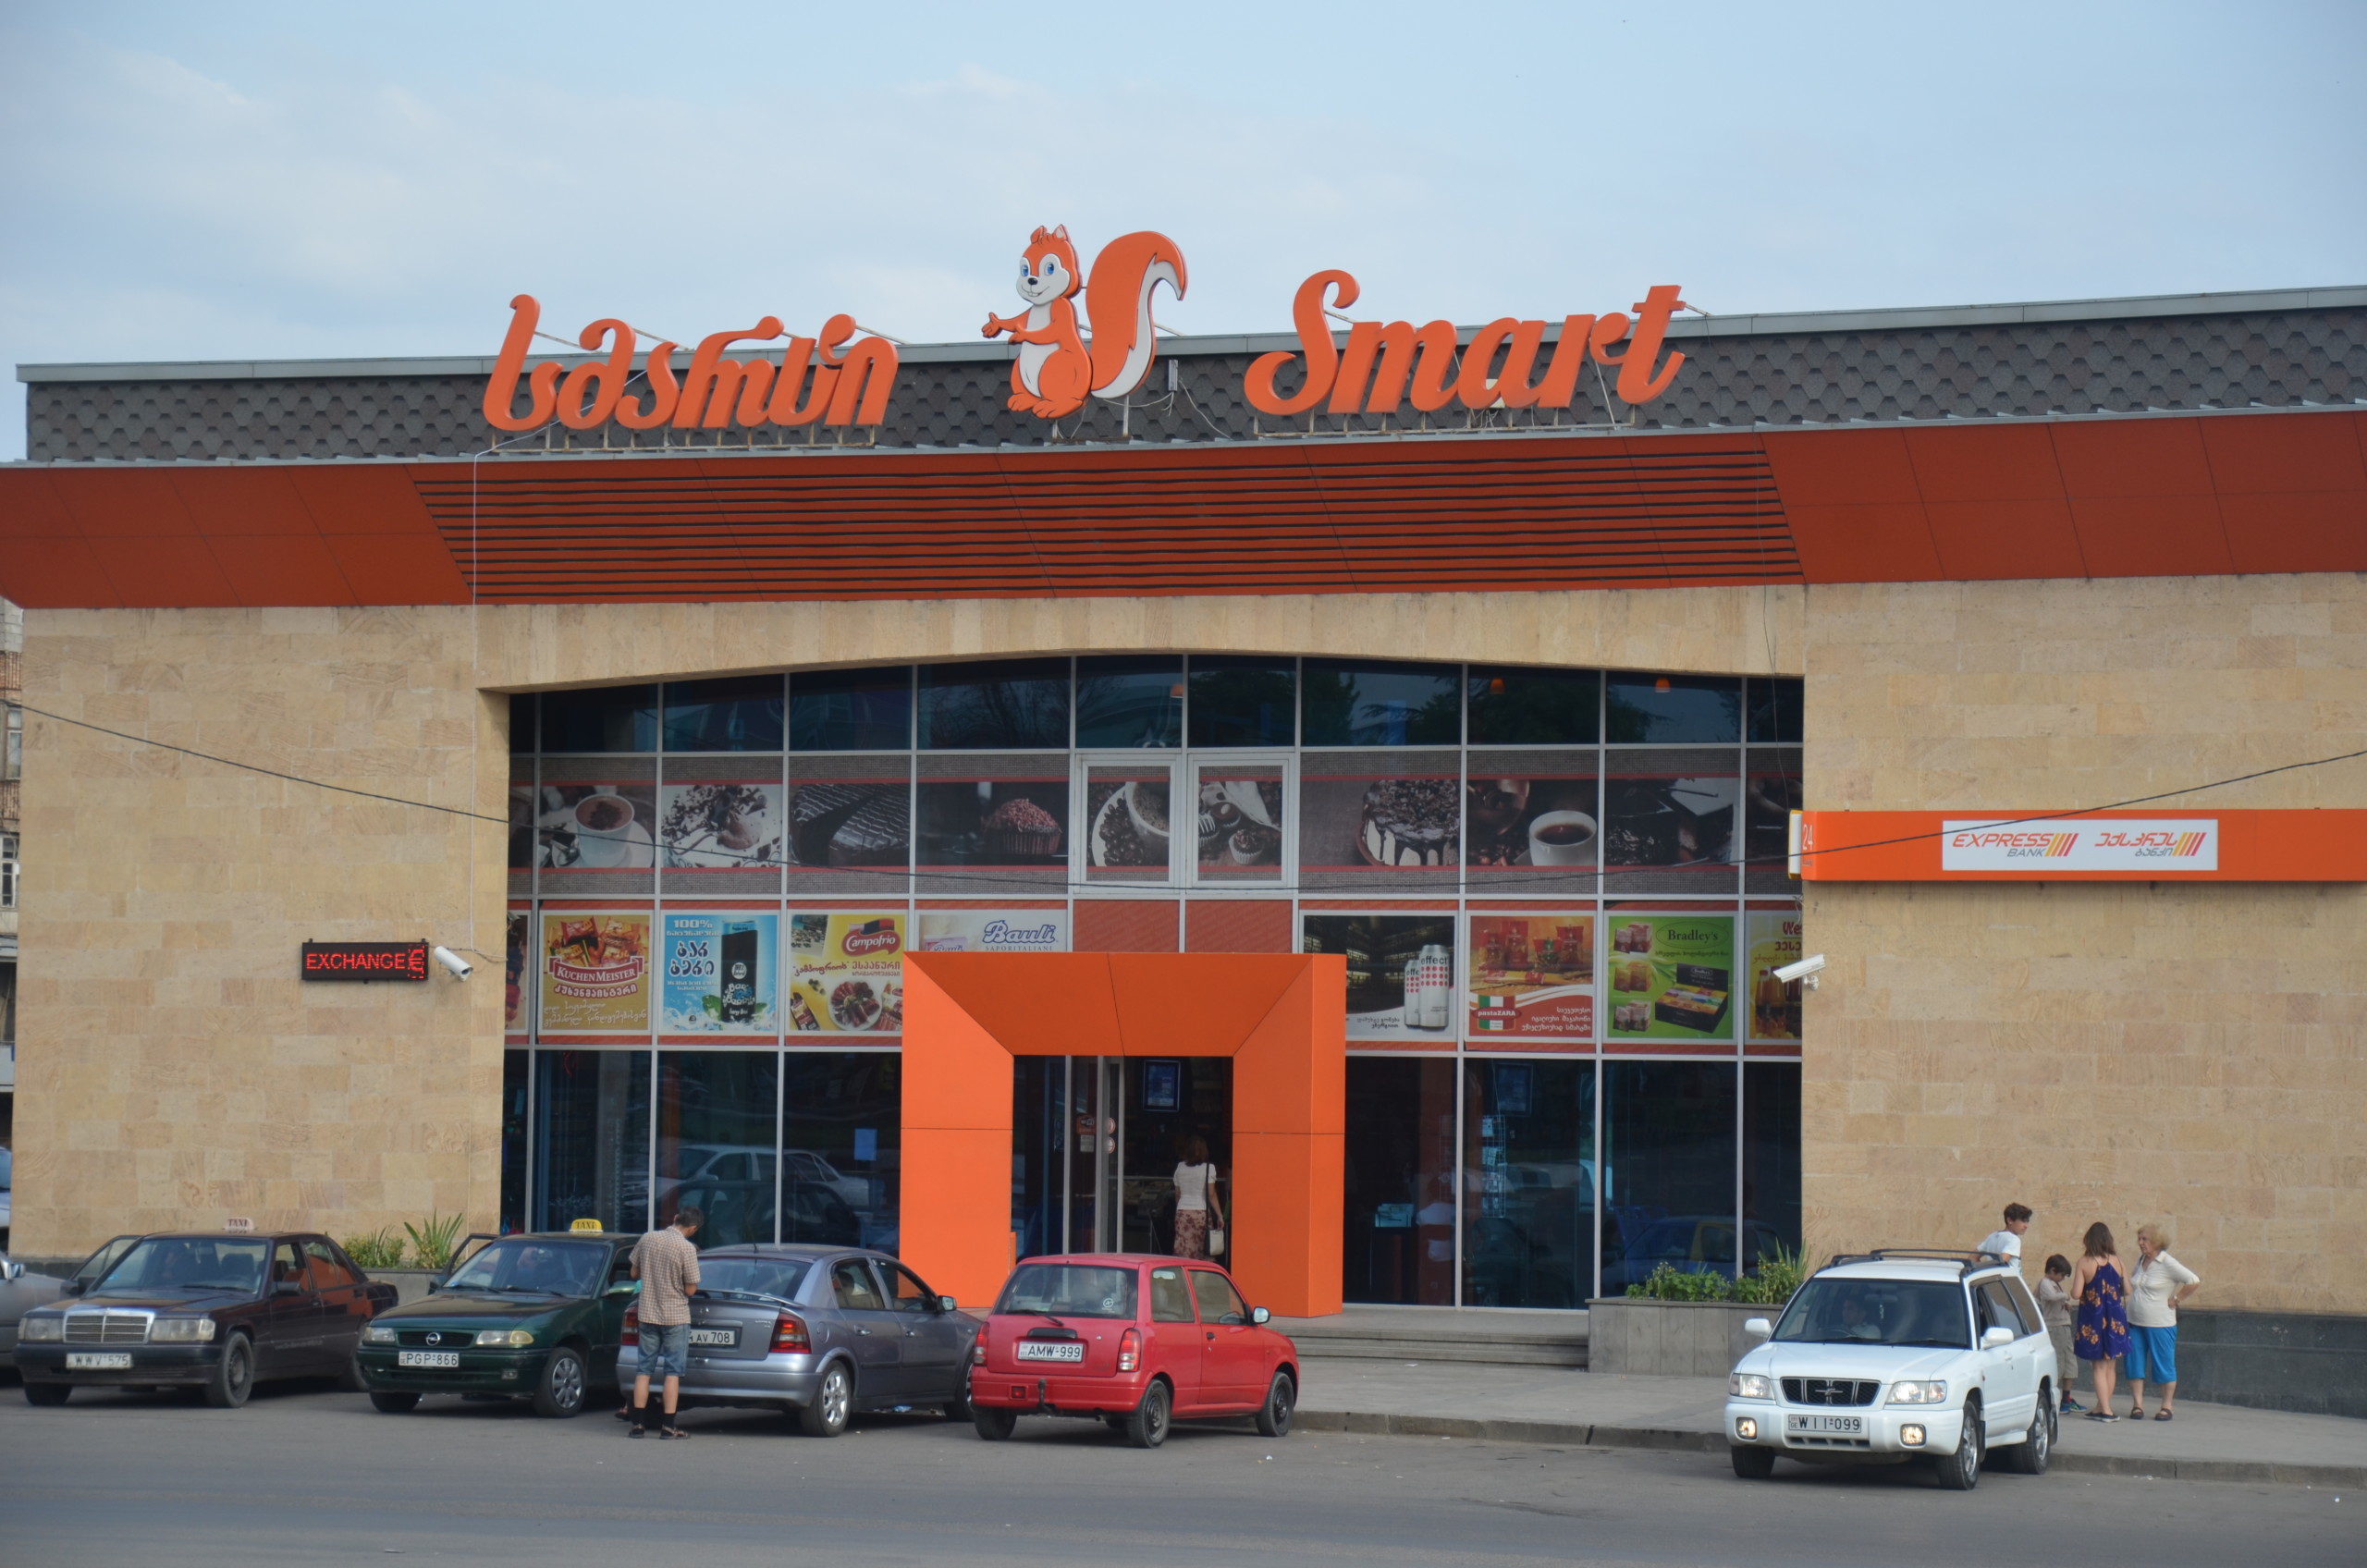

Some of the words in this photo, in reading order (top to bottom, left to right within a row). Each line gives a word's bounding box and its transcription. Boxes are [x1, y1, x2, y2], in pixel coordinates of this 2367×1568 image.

[1244, 268, 1686, 416] Smart
[1802, 824, 1813, 851] 24
[1953, 833, 2052, 847] EXPRESS
[2007, 848, 2046, 857] BANK
[674, 919, 714, 929] 100%
[983, 920, 1057, 944] Bauli
[1668, 929, 1718, 944] Bradley's
[845, 935, 897, 952] Campofrio
[306, 953, 406, 969] EXCHANGE
[1421, 955, 1448, 965] effect
[1478, 1010, 1515, 1019] pastaZARA
[227, 1219, 248, 1227] TAXI
[574, 1220, 595, 1230] TAXI
[696, 1333, 708, 1342] AV
[711, 1331, 730, 1343] 708
